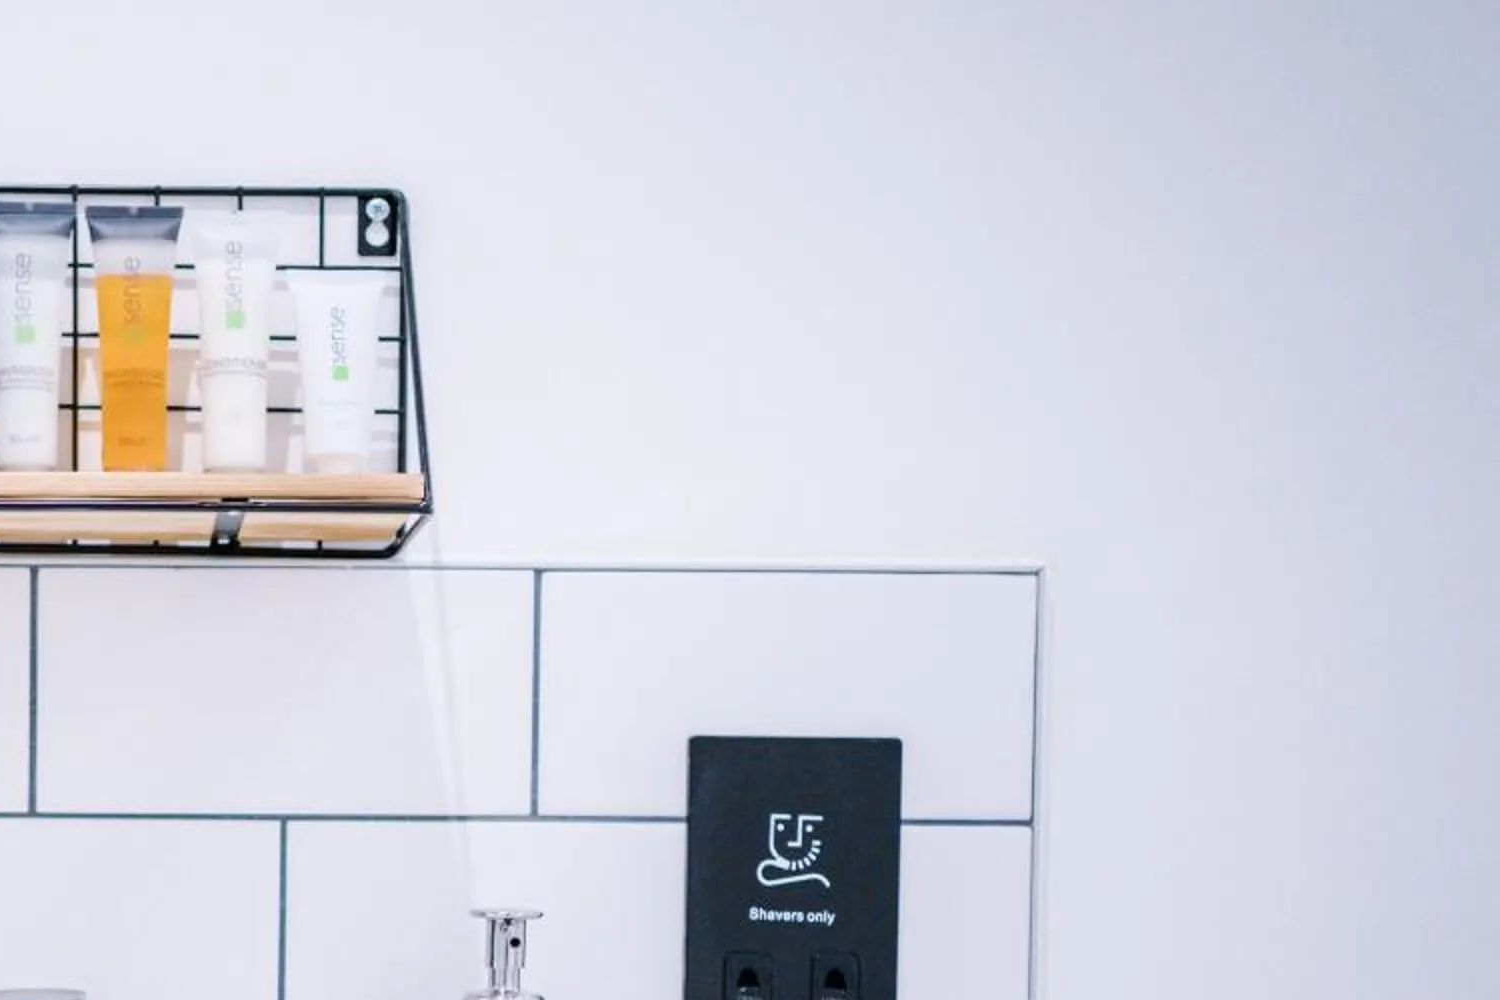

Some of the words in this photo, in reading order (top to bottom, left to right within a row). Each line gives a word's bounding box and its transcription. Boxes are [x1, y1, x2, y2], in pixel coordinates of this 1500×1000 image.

[14, 251, 33, 324] sense
[123, 255, 142, 324] sense
[224, 239, 244, 311] sense
[330, 305, 347, 366] sense
[749, 906, 805, 922] Shavers
[807, 910, 836, 926] only
